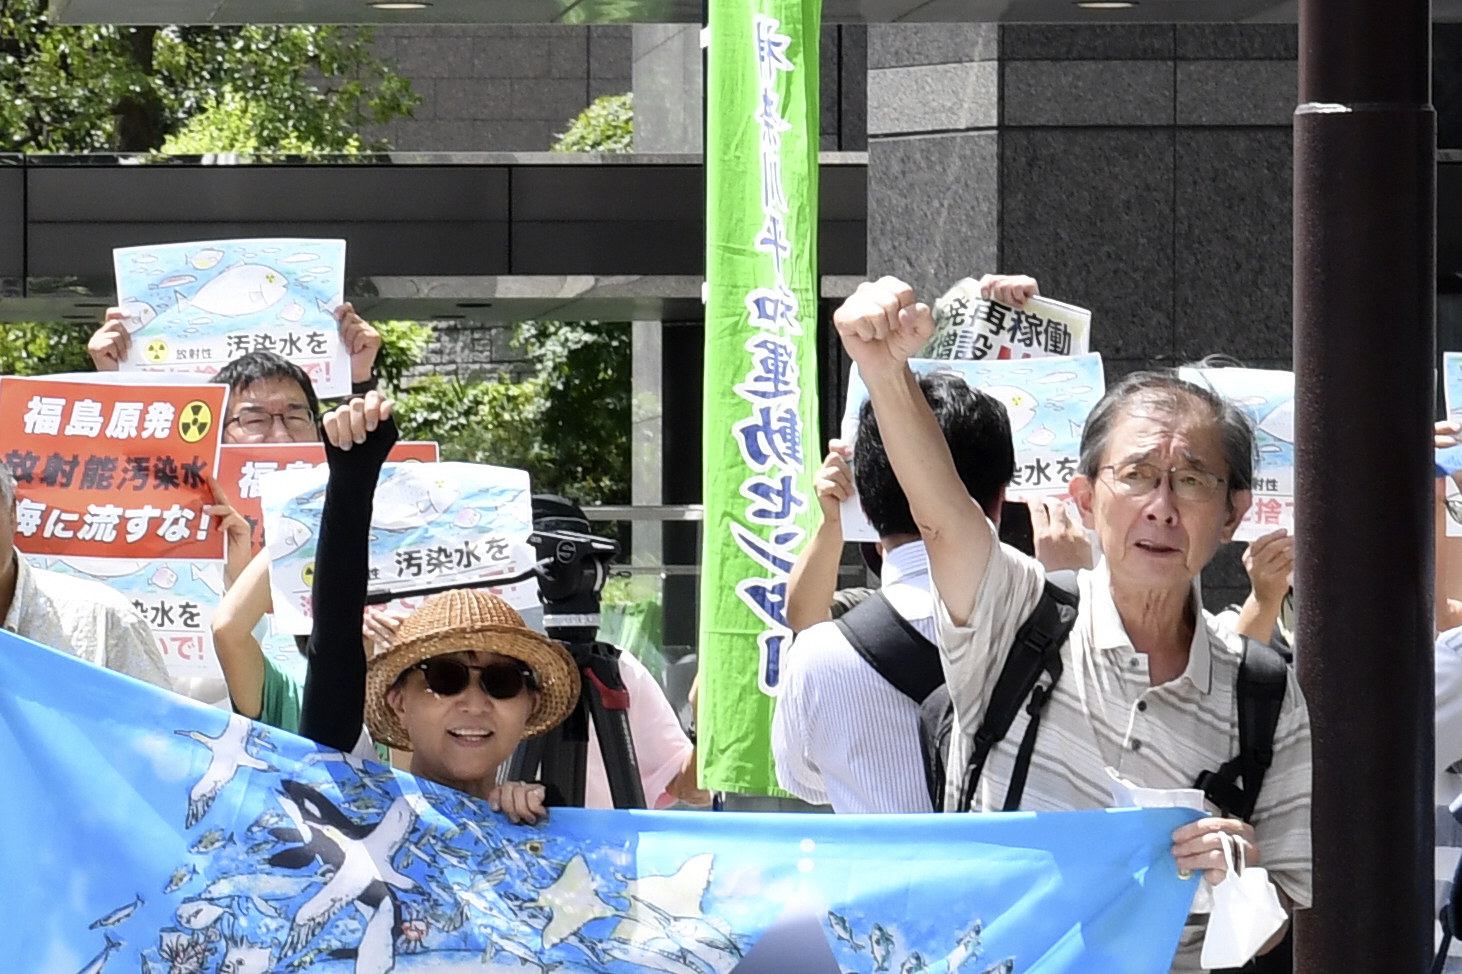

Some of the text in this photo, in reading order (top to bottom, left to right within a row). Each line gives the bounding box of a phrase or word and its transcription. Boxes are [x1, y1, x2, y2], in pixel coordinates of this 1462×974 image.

[175, 347, 213, 361] 放射性
[23, 395, 176, 440] 福島原発
[5, 449, 208, 492] 放射能汚染水
[395, 537, 511, 578] 汚染水を
